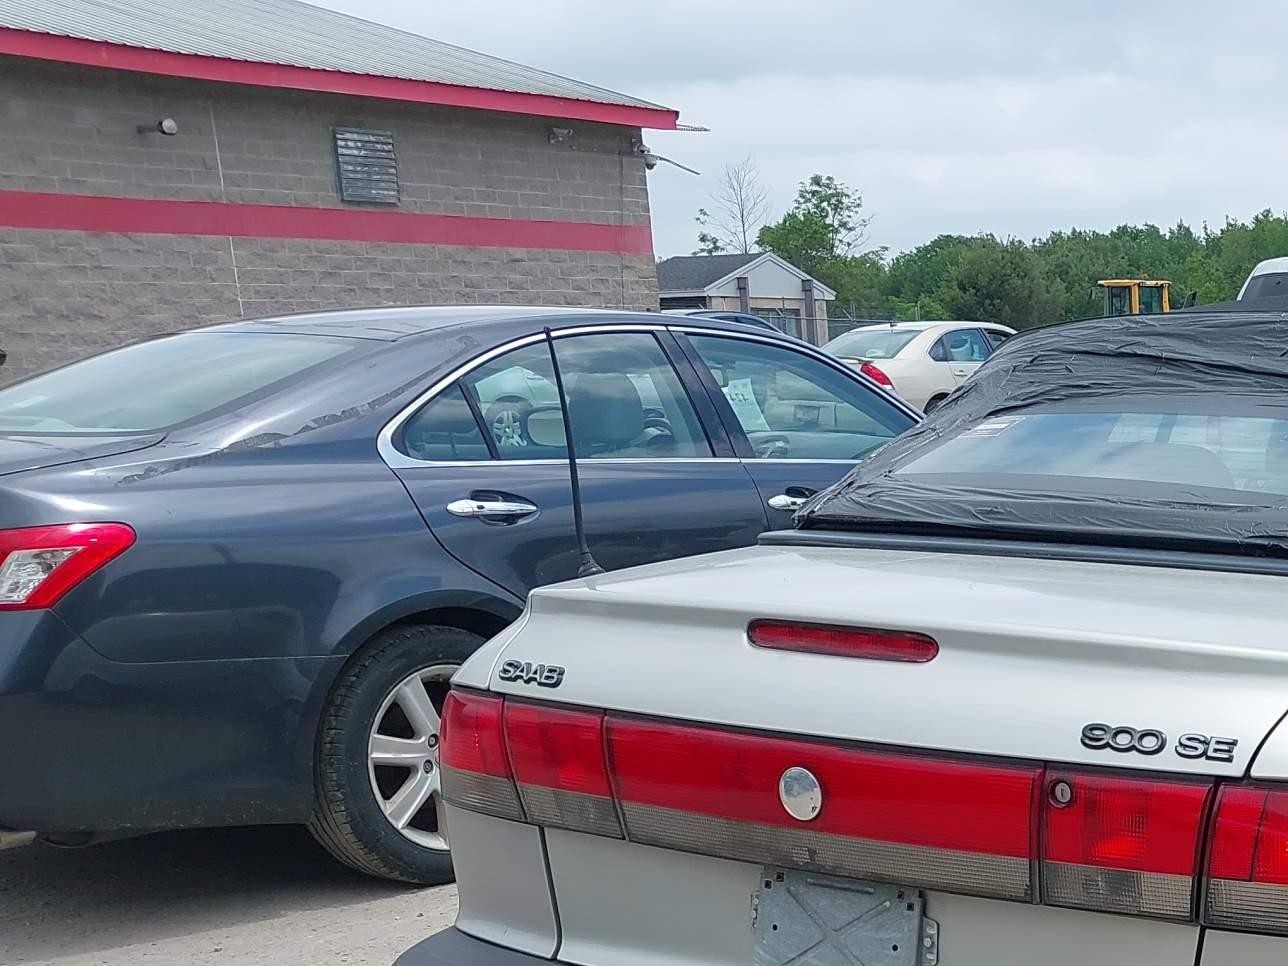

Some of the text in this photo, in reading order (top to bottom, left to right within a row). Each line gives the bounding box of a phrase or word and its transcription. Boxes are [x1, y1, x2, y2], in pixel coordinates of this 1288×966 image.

[499, 659, 565, 689] SAAB
[1080, 723, 1239, 763] 900 SE
